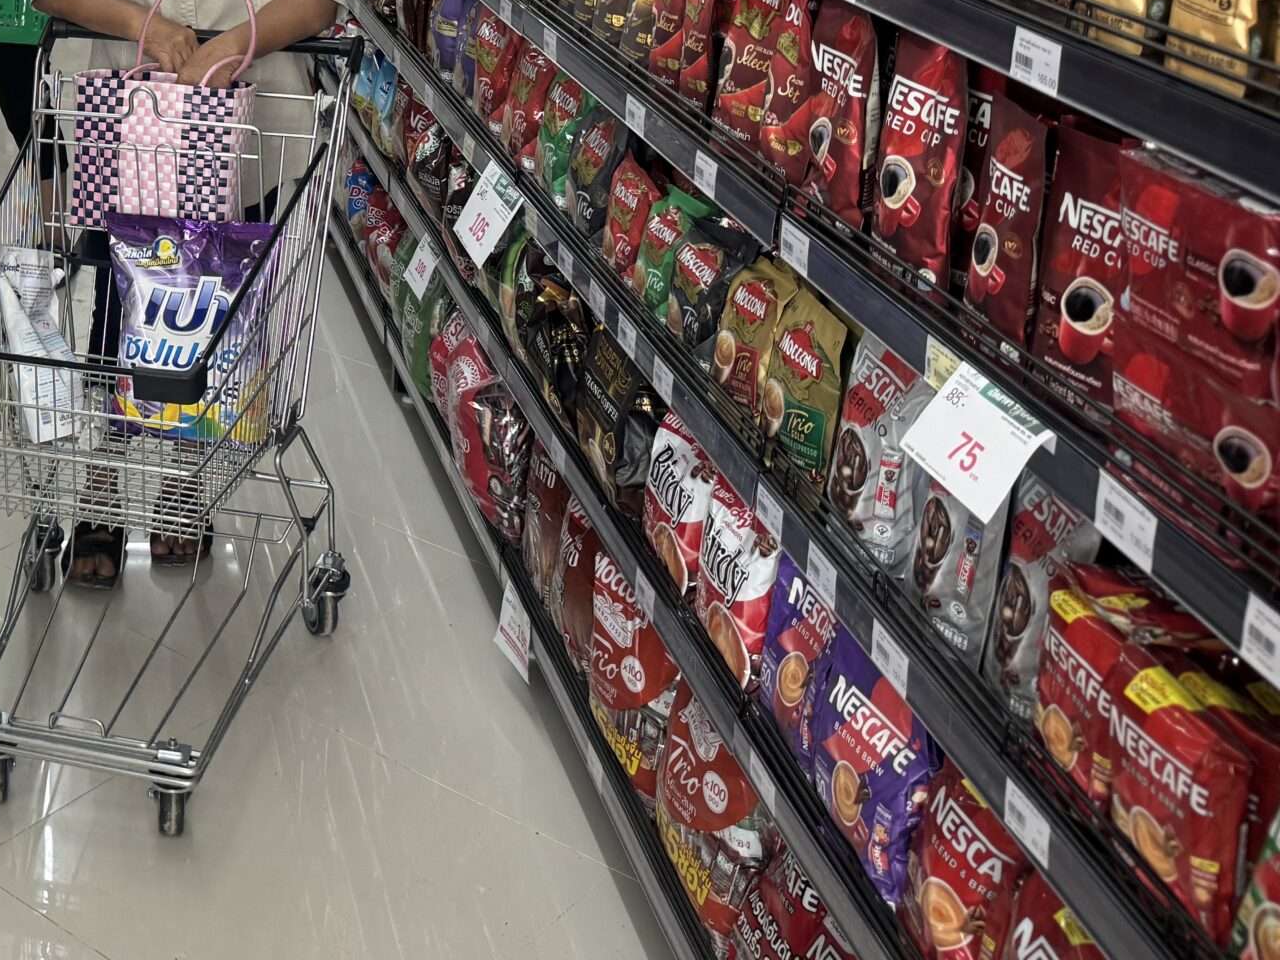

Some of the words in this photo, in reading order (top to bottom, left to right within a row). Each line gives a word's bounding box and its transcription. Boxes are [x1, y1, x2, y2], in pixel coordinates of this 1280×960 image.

[737, 43, 771, 72] Select
[886, 110, 917, 136] RED
[468, 212, 490, 242] 105
[1071, 235, 1100, 260] RED
[1123, 214, 1180, 262] ESCAFE
[677, 245, 719, 287] MOCCONA
[1144, 251, 1167, 270] CUP
[734, 283, 769, 321] MOCCONA
[779, 330, 822, 379] MOCCONA
[785, 408, 817, 435] Trio
[947, 431, 985, 472] 75
[649, 439, 695, 529] Birdy
[828, 674, 917, 774] NESCAFE
[669, 734, 701, 796] Trio
[834, 721, 856, 748] BLEND
[862, 752, 885, 778] BREW
[1109, 704, 1212, 817] NESCAFE
[703, 778, 726, 803] x100
[929, 785, 1003, 885] NESCA
[931, 833, 958, 871] BLEND
[968, 877, 996, 902] BRE
